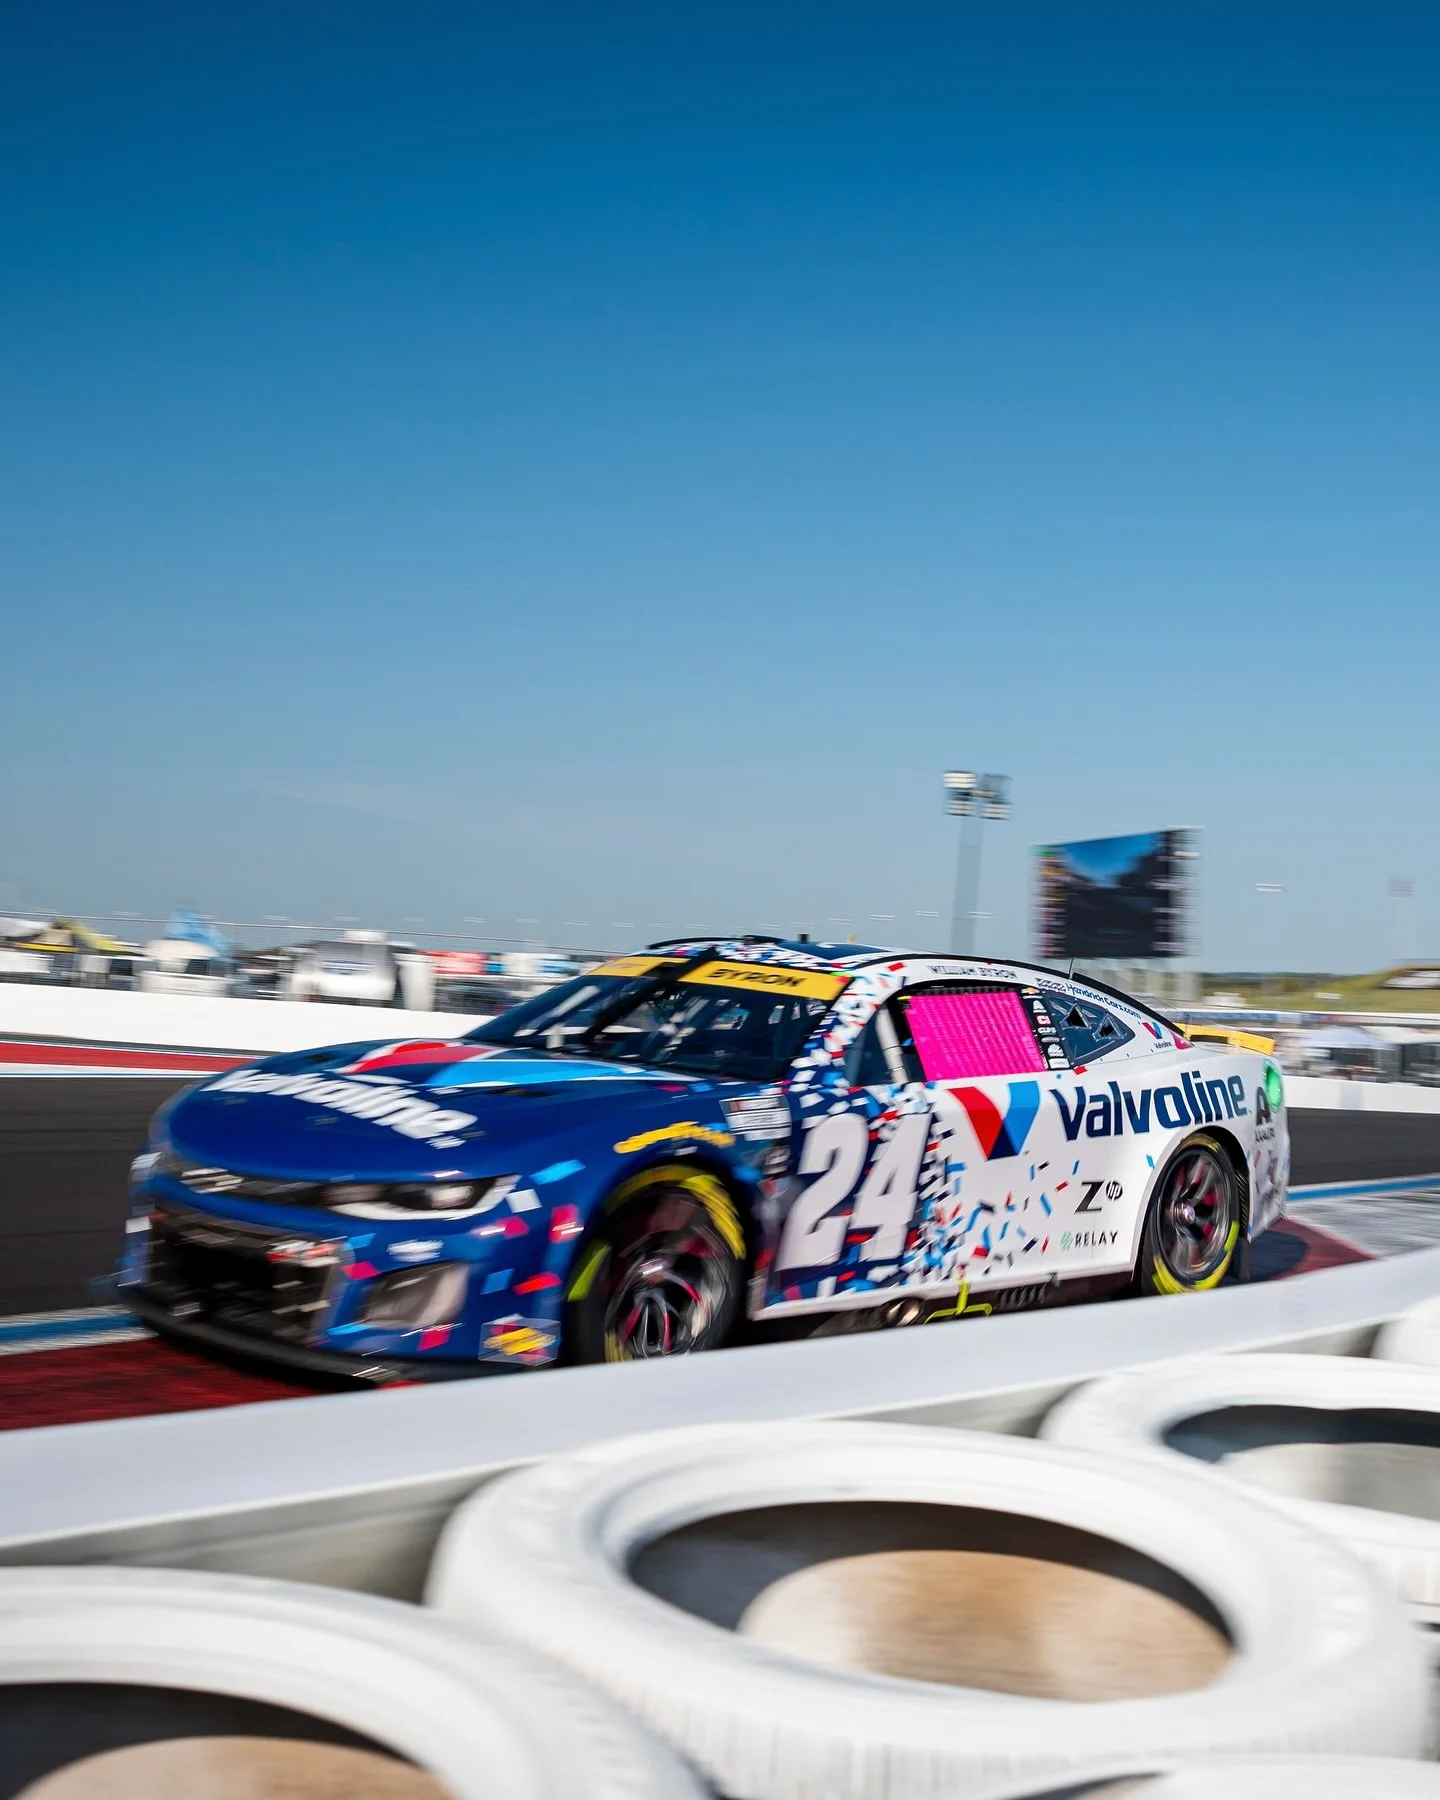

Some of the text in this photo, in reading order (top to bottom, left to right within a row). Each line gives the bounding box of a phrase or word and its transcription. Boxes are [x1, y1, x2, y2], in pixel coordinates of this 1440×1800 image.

[706, 968, 806, 988] BYRON
[928, 965, 1018, 979] WILLIAM BYRON
[200, 1069, 478, 1139] Valvoline
[1049, 1070, 1247, 1141] Valvoline
[774, 1112, 932, 1272] 24
[1073, 1179, 1123, 1215] Z hp
[1074, 1231, 1119, 1248] RELAY
